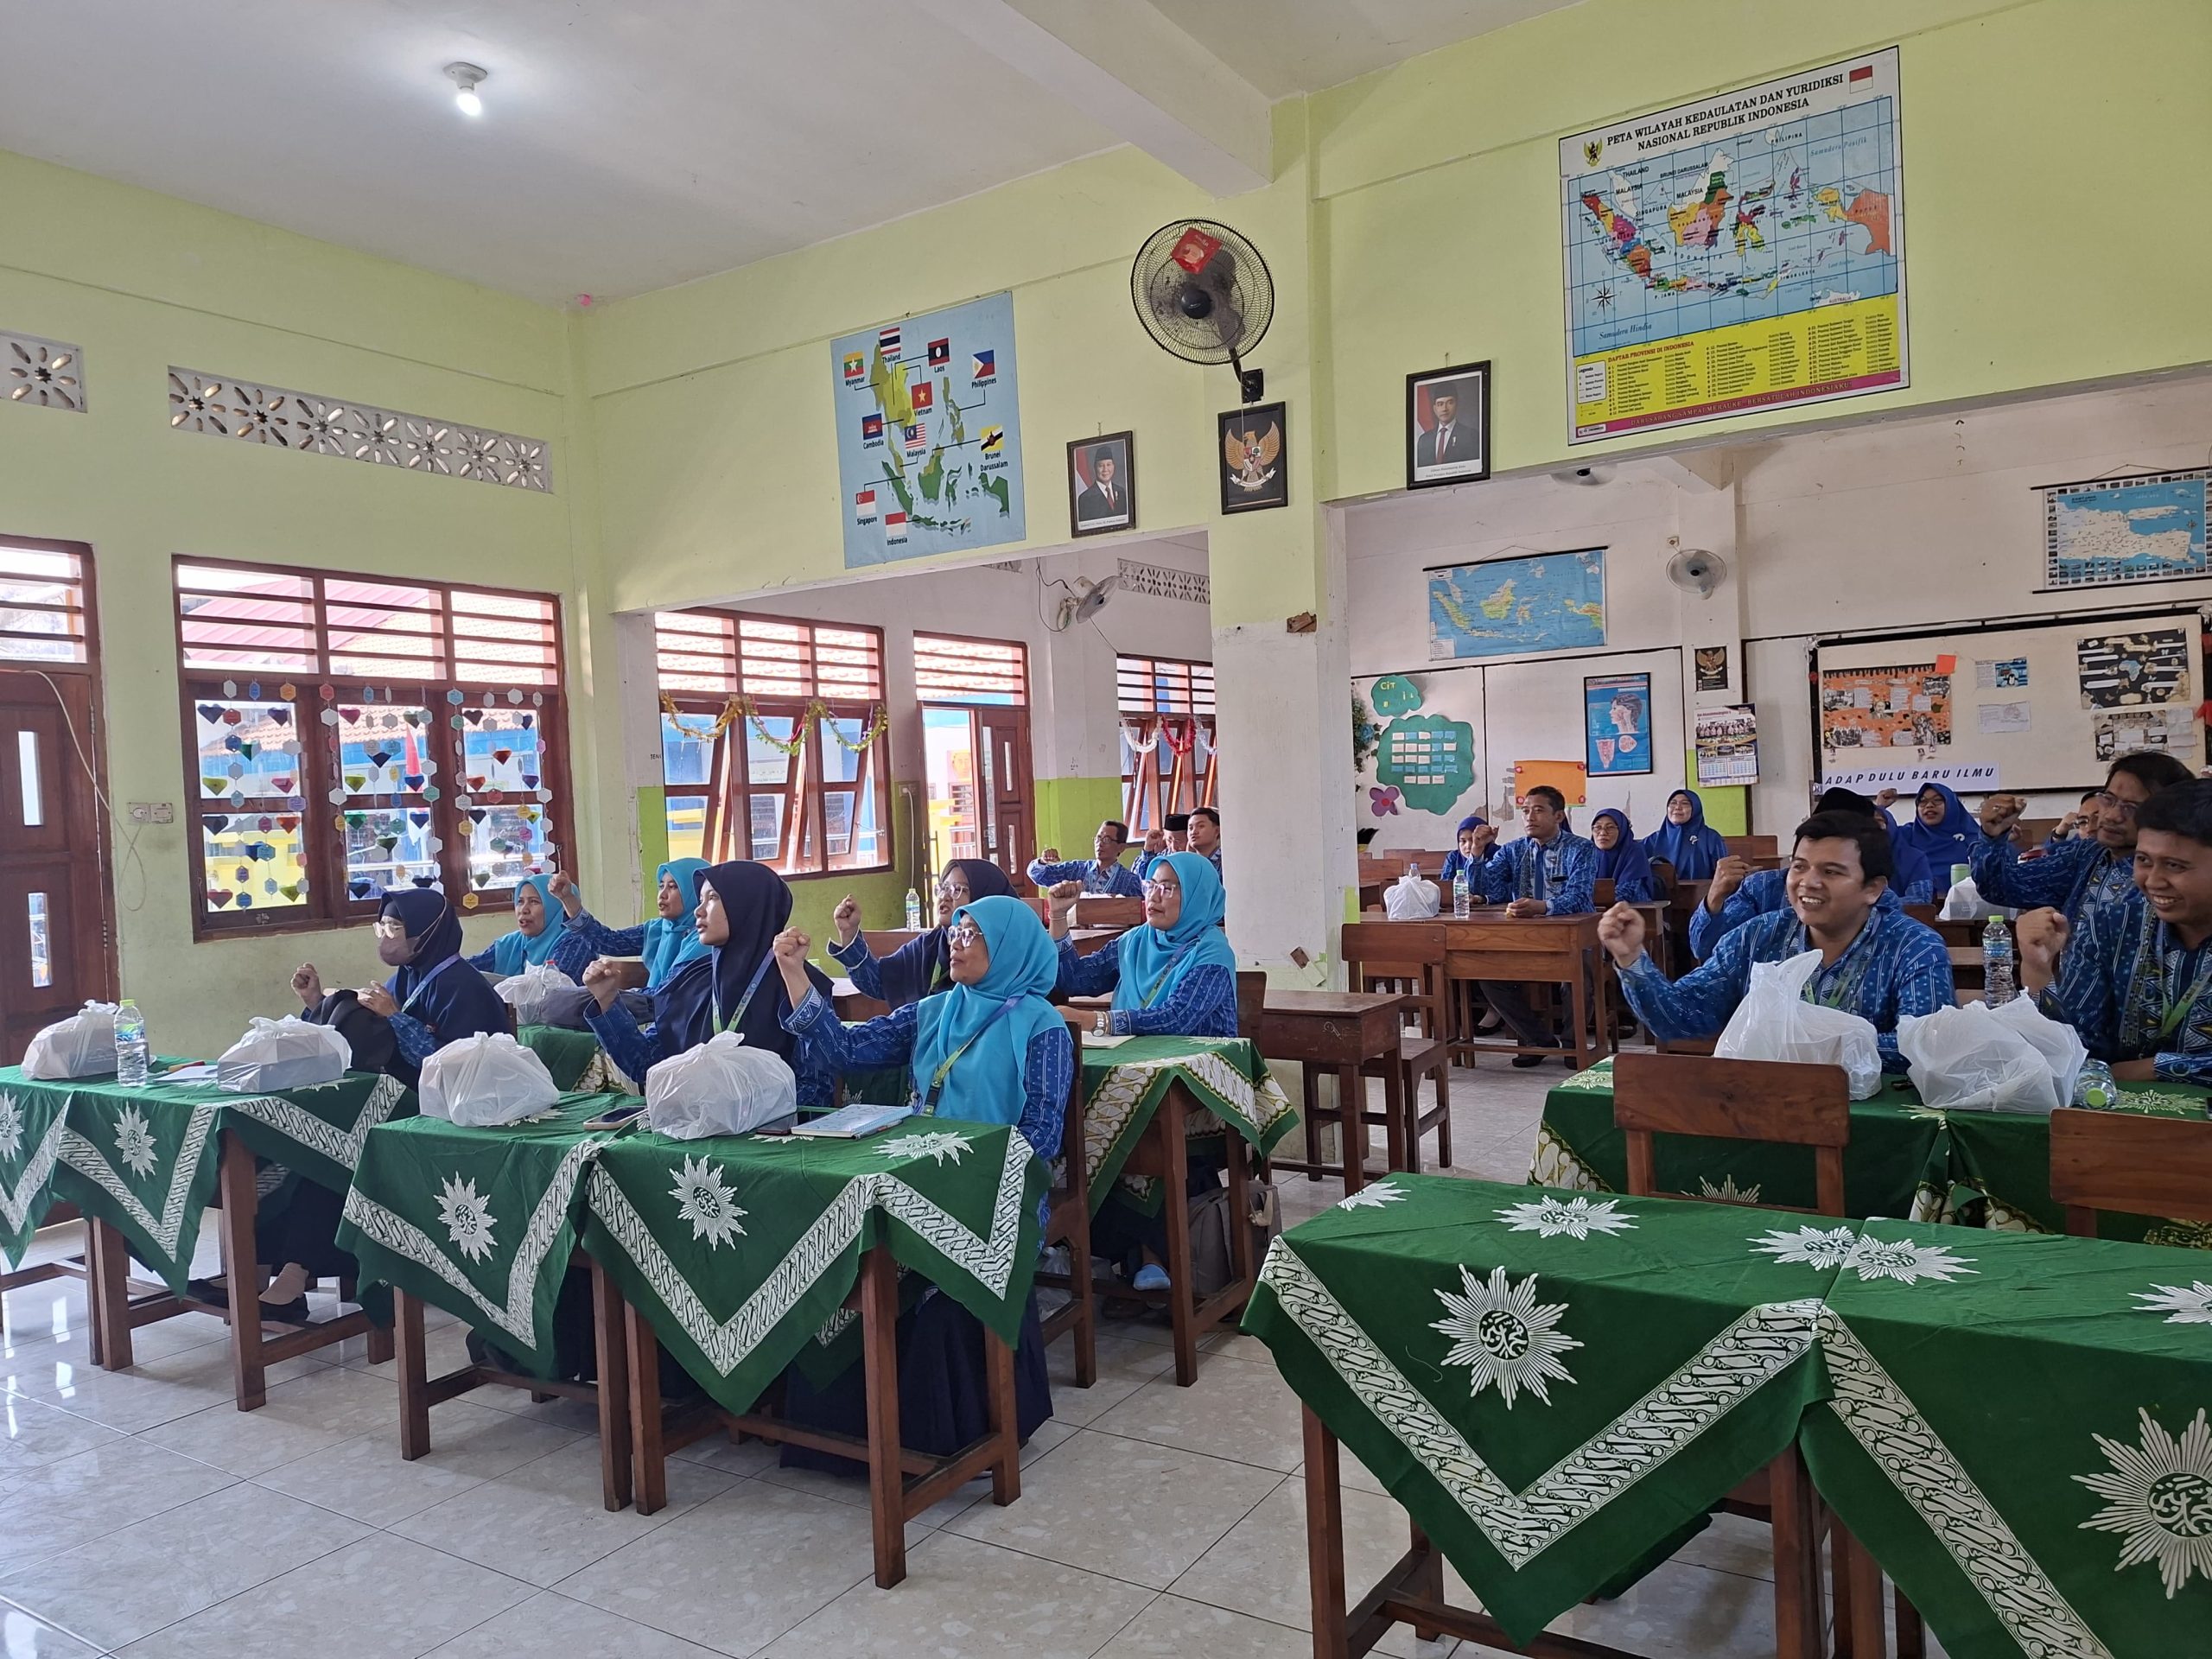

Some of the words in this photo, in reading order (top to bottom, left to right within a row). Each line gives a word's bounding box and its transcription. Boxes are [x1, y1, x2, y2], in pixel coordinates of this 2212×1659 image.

[1607, 133, 1633, 146] PETA
[1635, 117, 1683, 139] WILAYAH
[1685, 97, 1758, 125] KEDAULATAN
[1759, 90, 1784, 105] DAN
[1785, 73, 1844, 98] YURIDIKSI
[1637, 130, 1691, 151] NASIONAL
[1693, 115, 1746, 137] REPUBLIK
[1748, 97, 1810, 122] INDONESIA
[1623, 166, 1649, 178] THAILAND
[1616, 183, 1643, 195] MALAYSIA
[1676, 188, 1703, 199] MALAYSIA
[1599, 328, 1628, 340] Samudera
[1630, 322, 1652, 334] Hindia
[1630, 349, 1656, 359] PROVINSI
[1663, 341, 1694, 353] INDONESIA
[881, 353, 901, 364] Thailand
[933, 365, 945, 373] Laos
[845, 376, 866, 388] Myanmar
[971, 377, 997, 389] Philippines
[913, 406, 933, 416] Vietnam
[862, 438, 885, 450] Cambodia
[906, 448, 927, 459] Malaysia
[984, 451, 1001, 461] Brunei
[980, 461, 1009, 473] Darussalam
[856, 516, 878, 526] Singapore
[887, 536, 908, 547] Indonesia
[1825, 774, 1864, 785] ADAP
[1868, 772, 1905, 782] DULU
[1911, 769, 1951, 779] BARU
[1956, 767, 1994, 779] ILMU
